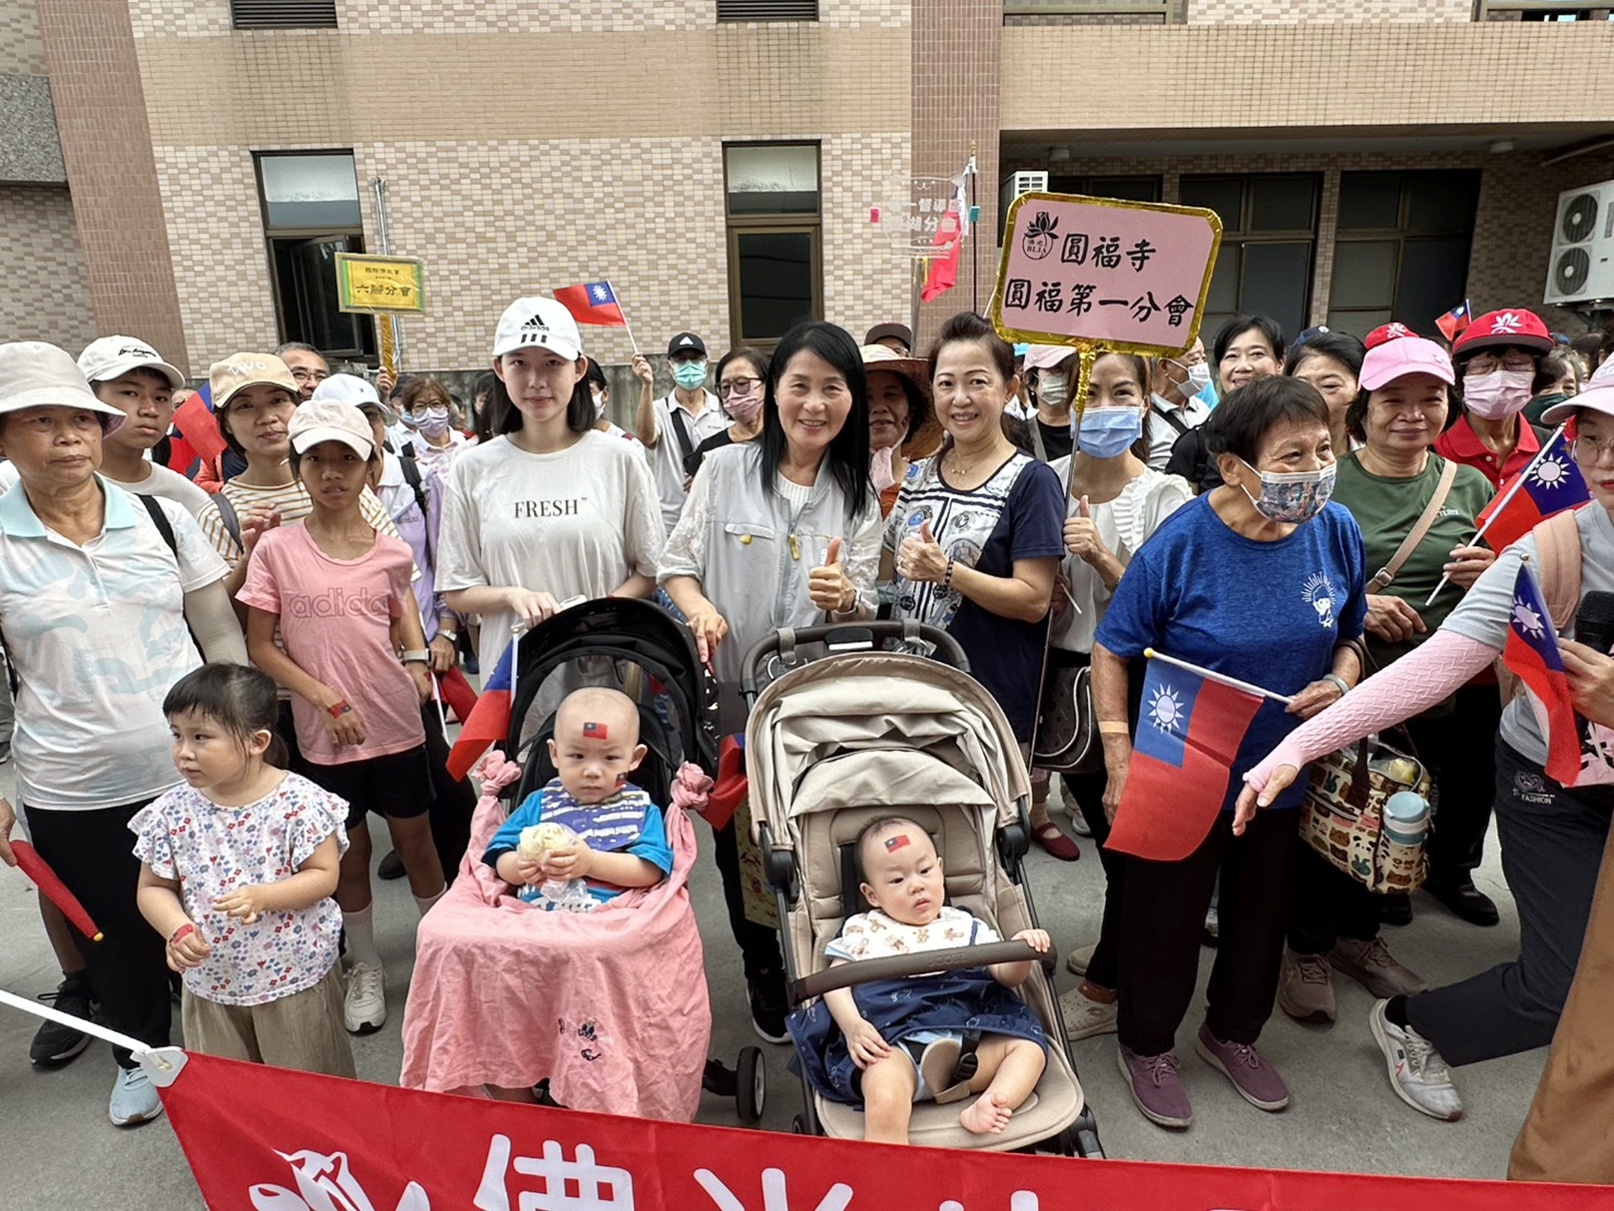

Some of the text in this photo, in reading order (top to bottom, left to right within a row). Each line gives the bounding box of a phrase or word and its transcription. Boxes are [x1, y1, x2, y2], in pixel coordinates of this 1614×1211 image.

[1061, 233, 1157, 272] 圓福寺
[1004, 278, 1195, 327] 圓福第一分會
[289, 587, 389, 618] adida
